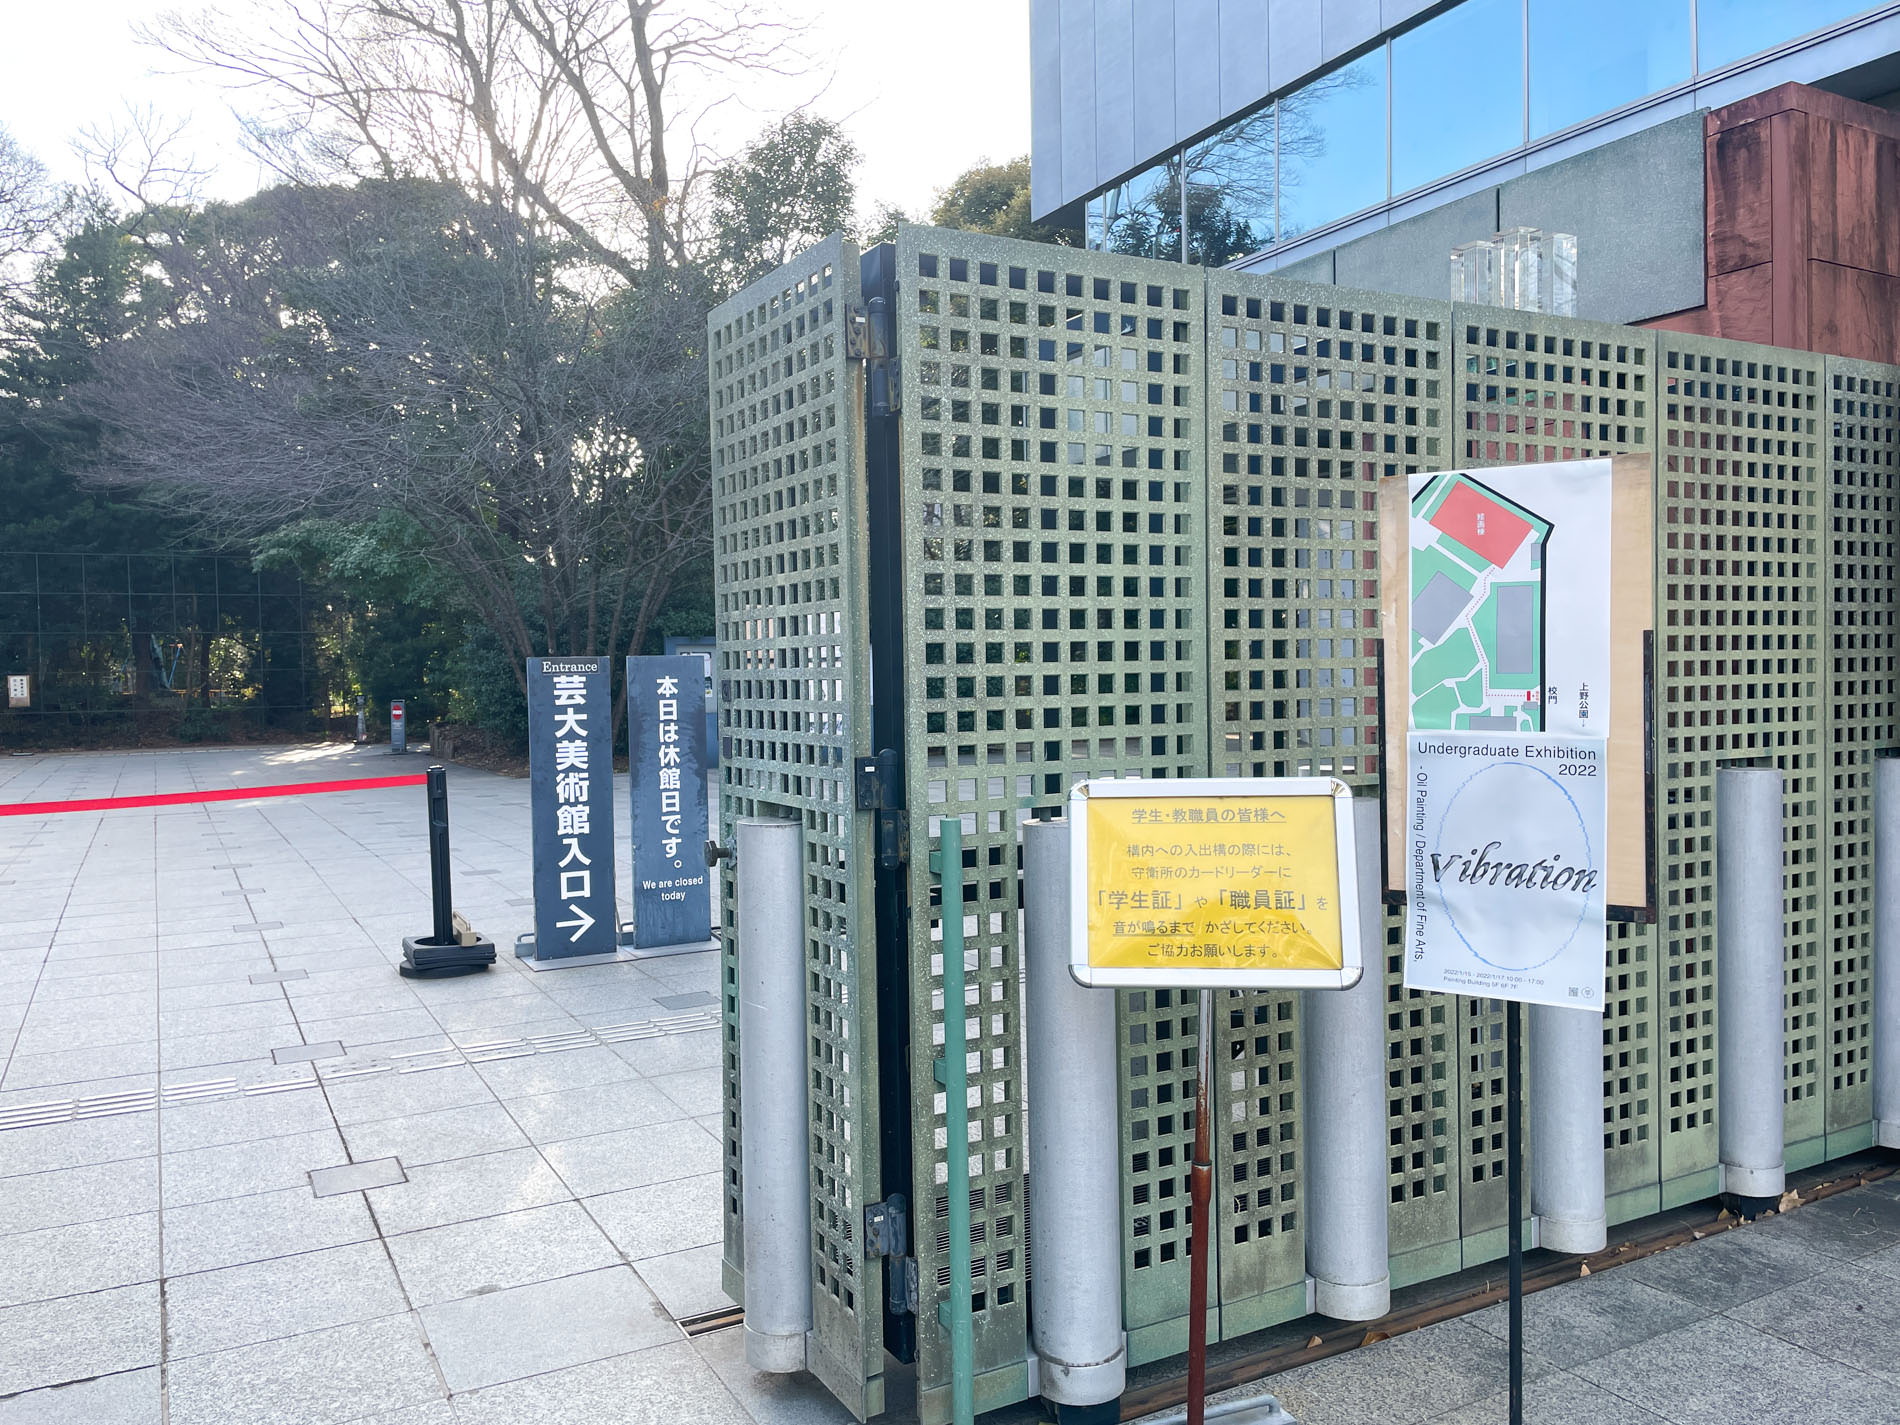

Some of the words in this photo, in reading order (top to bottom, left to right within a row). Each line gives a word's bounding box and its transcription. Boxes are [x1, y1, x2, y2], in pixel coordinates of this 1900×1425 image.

[542, 661, 598, 673] Entrance
[1548, 686, 1558, 704] 校門
[1579, 682, 1589, 719] 上野公園
[1418, 741, 1519, 759] Undergraduate
[1525, 745, 1596, 761] Exhibition
[656, 675, 682, 869] 本日は休館日です。
[1416, 772, 1428, 787] Oil
[1558, 763, 1597, 777] 2022
[553, 675, 592, 900] 芸大美術館入口
[1413, 790, 1428, 831] Painting
[1131, 865, 1292, 879] 守衛所のカードリーダーに
[1413, 840, 1427, 899] Department
[1430, 841, 1598, 893] Vibration
[642, 879, 656, 890] We
[658, 879, 673, 889] are
[674, 875, 704, 888] closed
[661, 891, 686, 901] today
[1416, 900, 1427, 912] of
[1415, 914, 1427, 937] Fine
